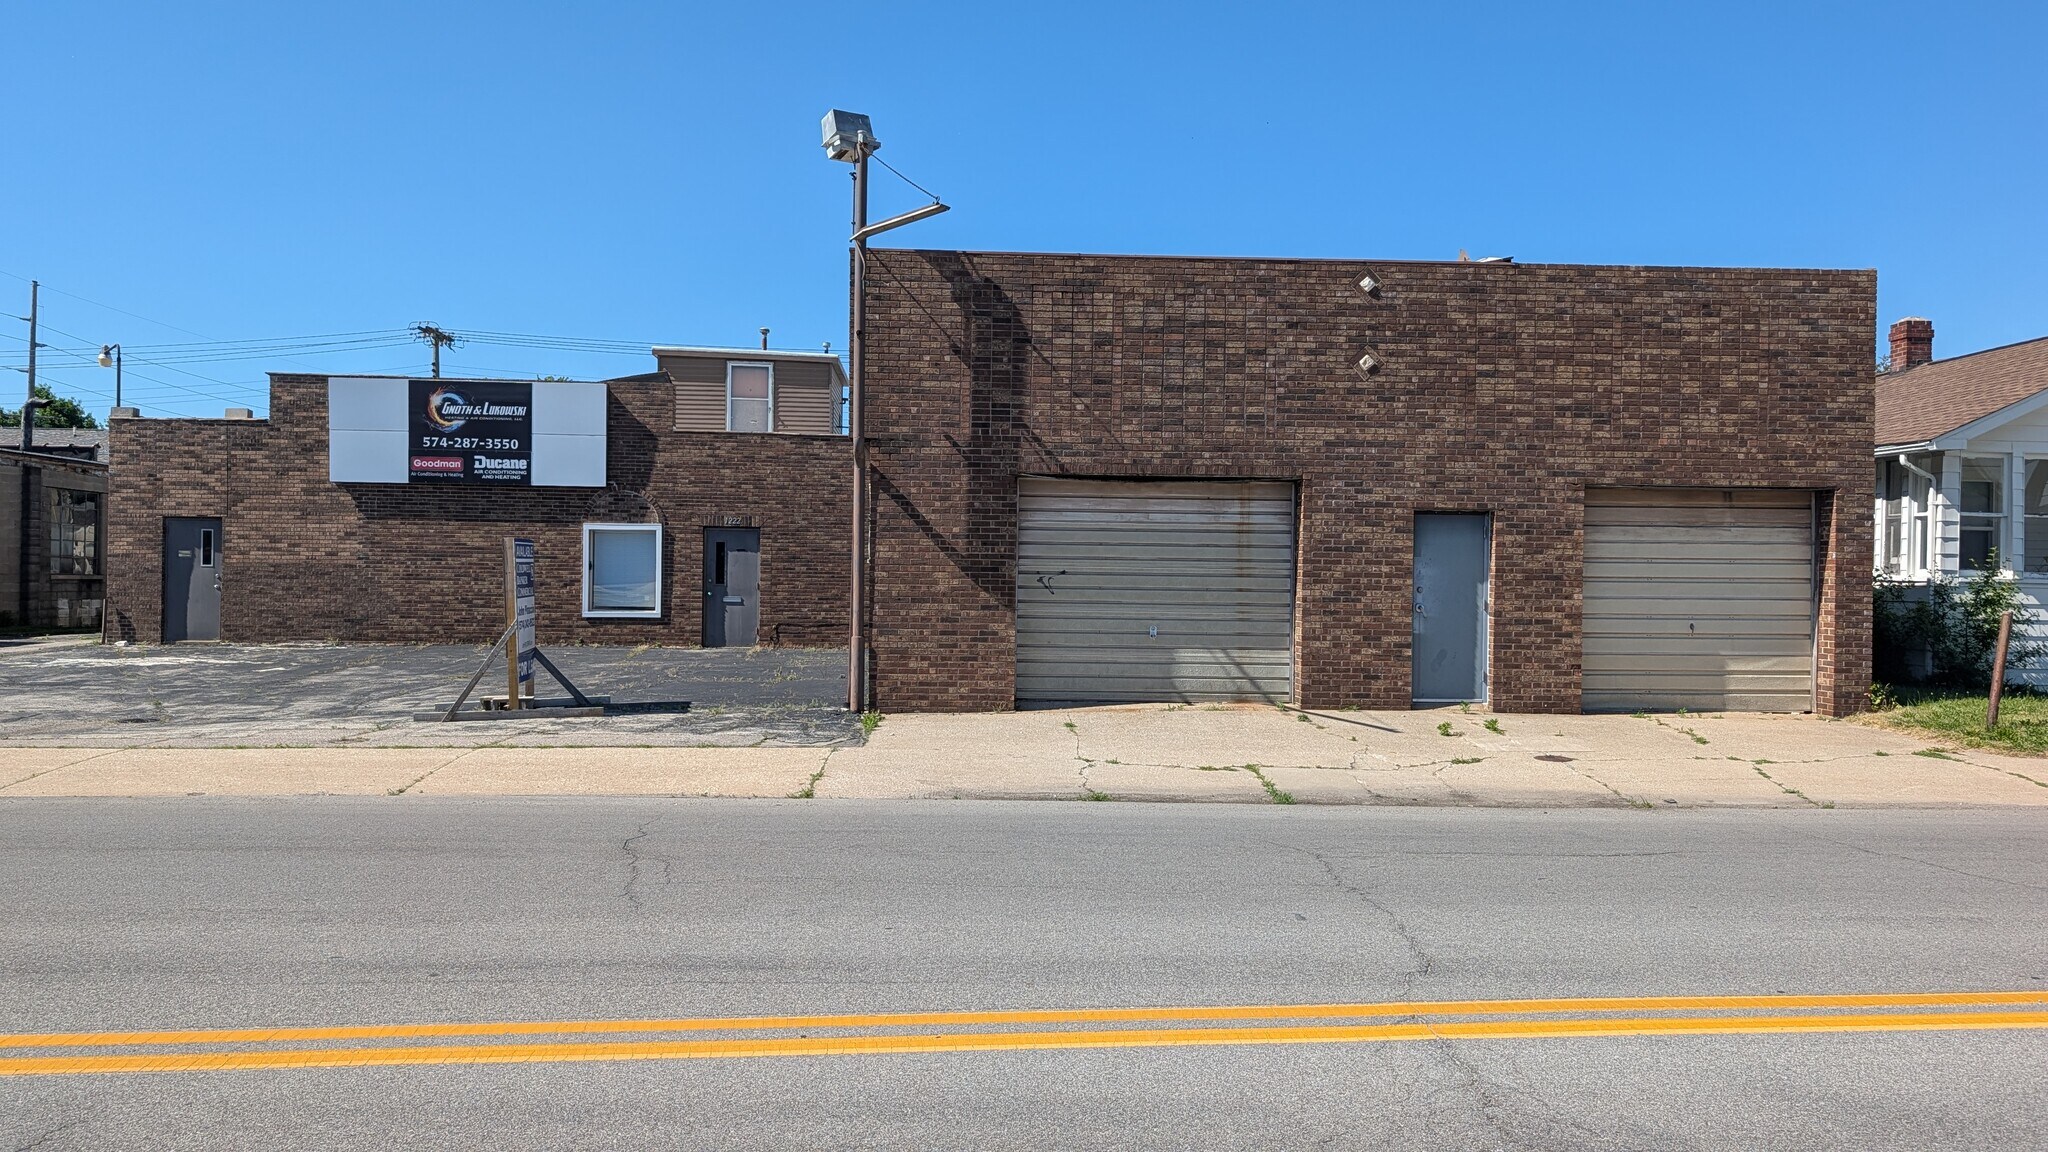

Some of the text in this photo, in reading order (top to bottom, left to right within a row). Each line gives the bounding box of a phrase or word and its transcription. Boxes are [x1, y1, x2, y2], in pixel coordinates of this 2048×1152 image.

[473, 405, 482, 415] &
[483, 402, 527, 416] LUKOWSKI
[423, 437, 519, 450] 574-287-3550
[413, 459, 461, 468] Goodman
[474, 455, 527, 470] Ducane
